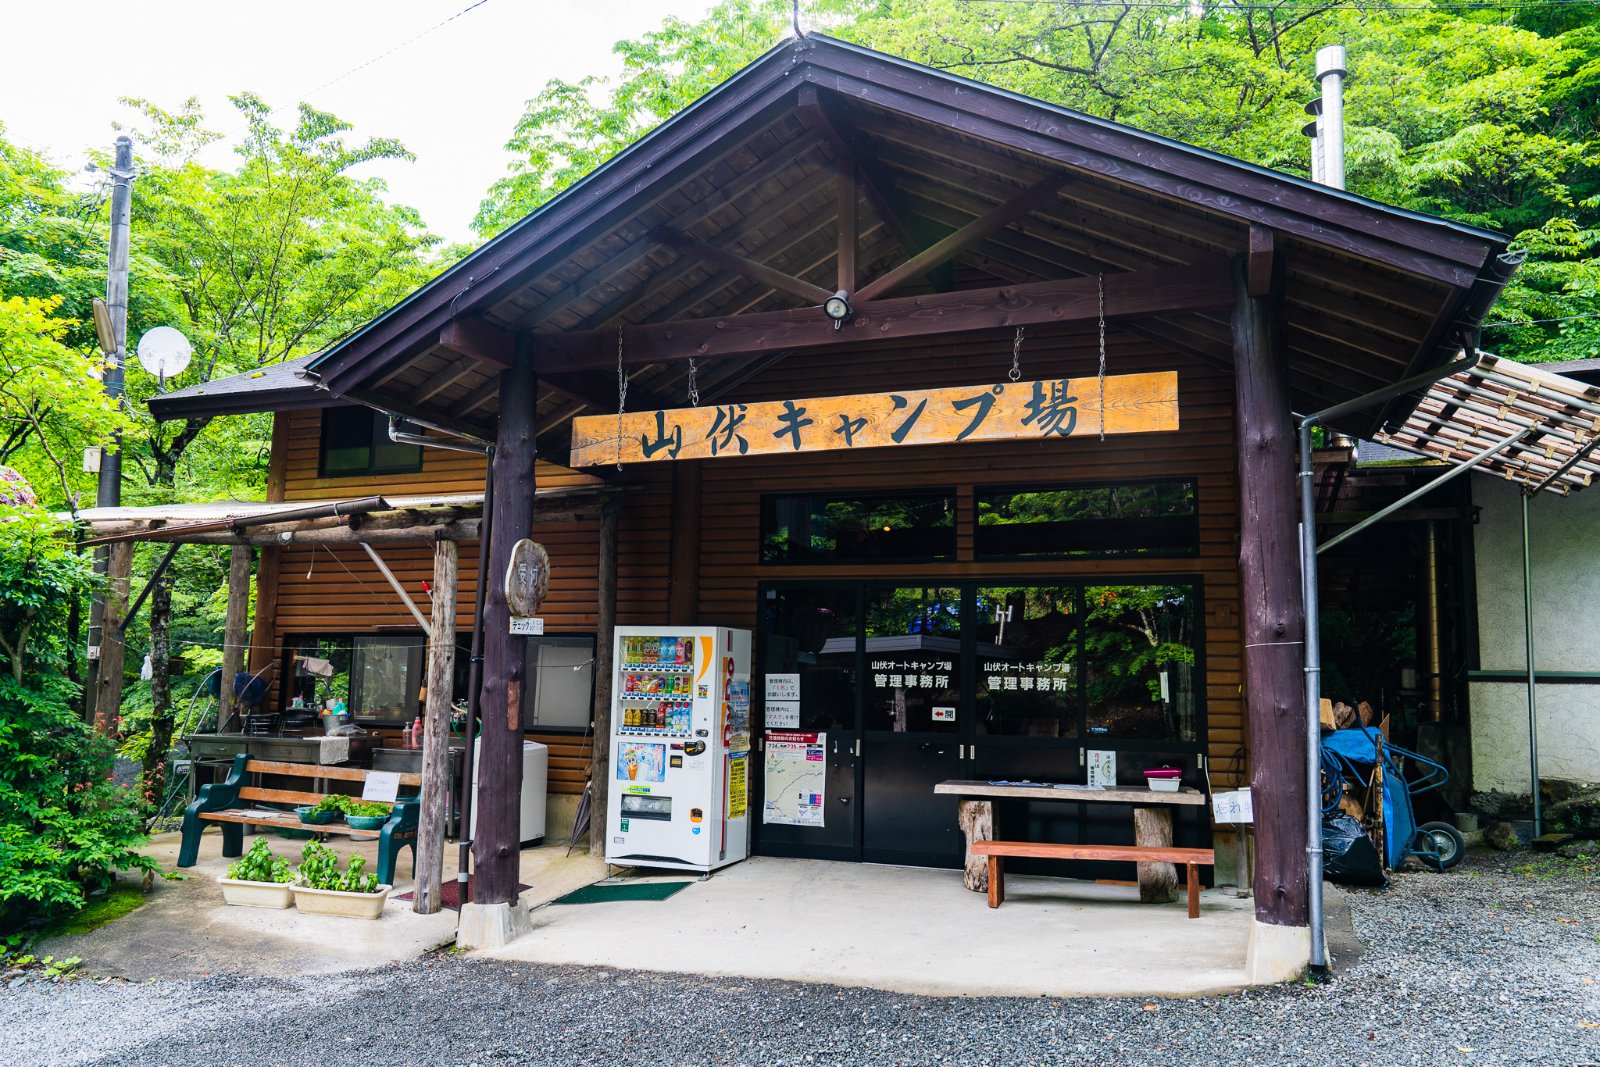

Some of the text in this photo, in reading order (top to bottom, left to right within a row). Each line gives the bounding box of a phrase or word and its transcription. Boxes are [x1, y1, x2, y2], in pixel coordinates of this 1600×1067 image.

[642, 379, 1078, 459] 山伏キャンプ場
[871, 660, 952, 672] 山伏オートキャンプ場
[984, 662, 1070, 673] 山伏オートキャンプ場
[874, 673, 949, 689] 管理事務所
[987, 676, 1067, 691] 管理事務所
[945, 709, 954, 719] 開
